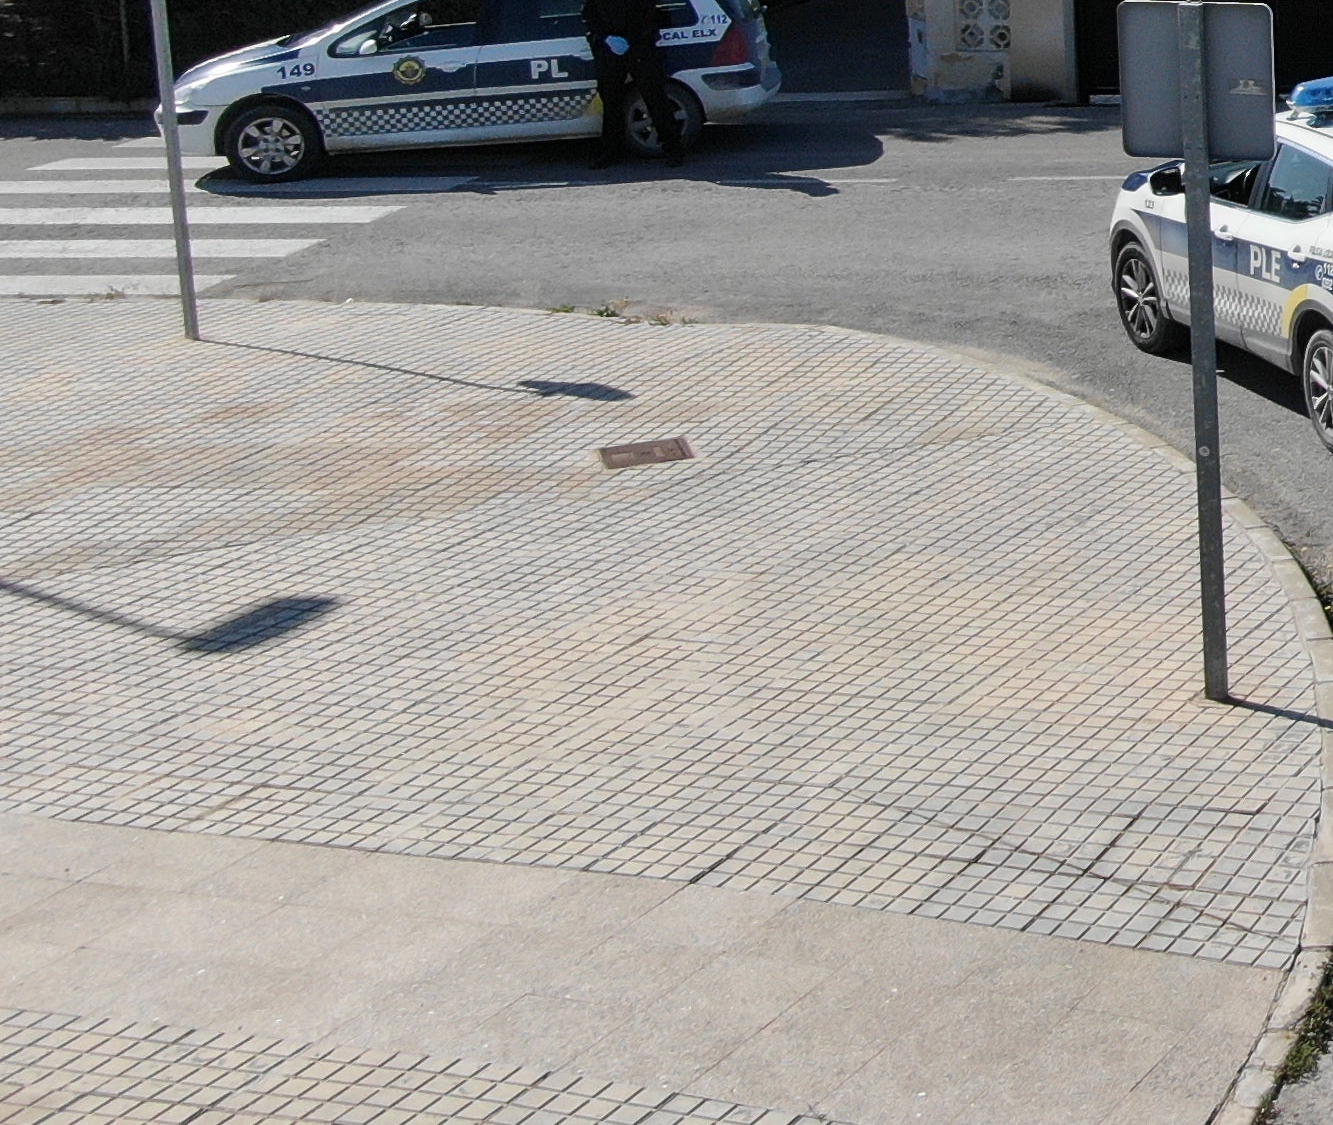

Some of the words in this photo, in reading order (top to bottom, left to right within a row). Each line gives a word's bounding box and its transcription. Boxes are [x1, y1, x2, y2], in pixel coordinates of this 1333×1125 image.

[711, 14, 728, 24] 112
[692, 28, 717, 38] ELX
[276, 62, 315, 80] 149
[530, 58, 569, 80] PL
[1249, 244, 1281, 283] PLE
